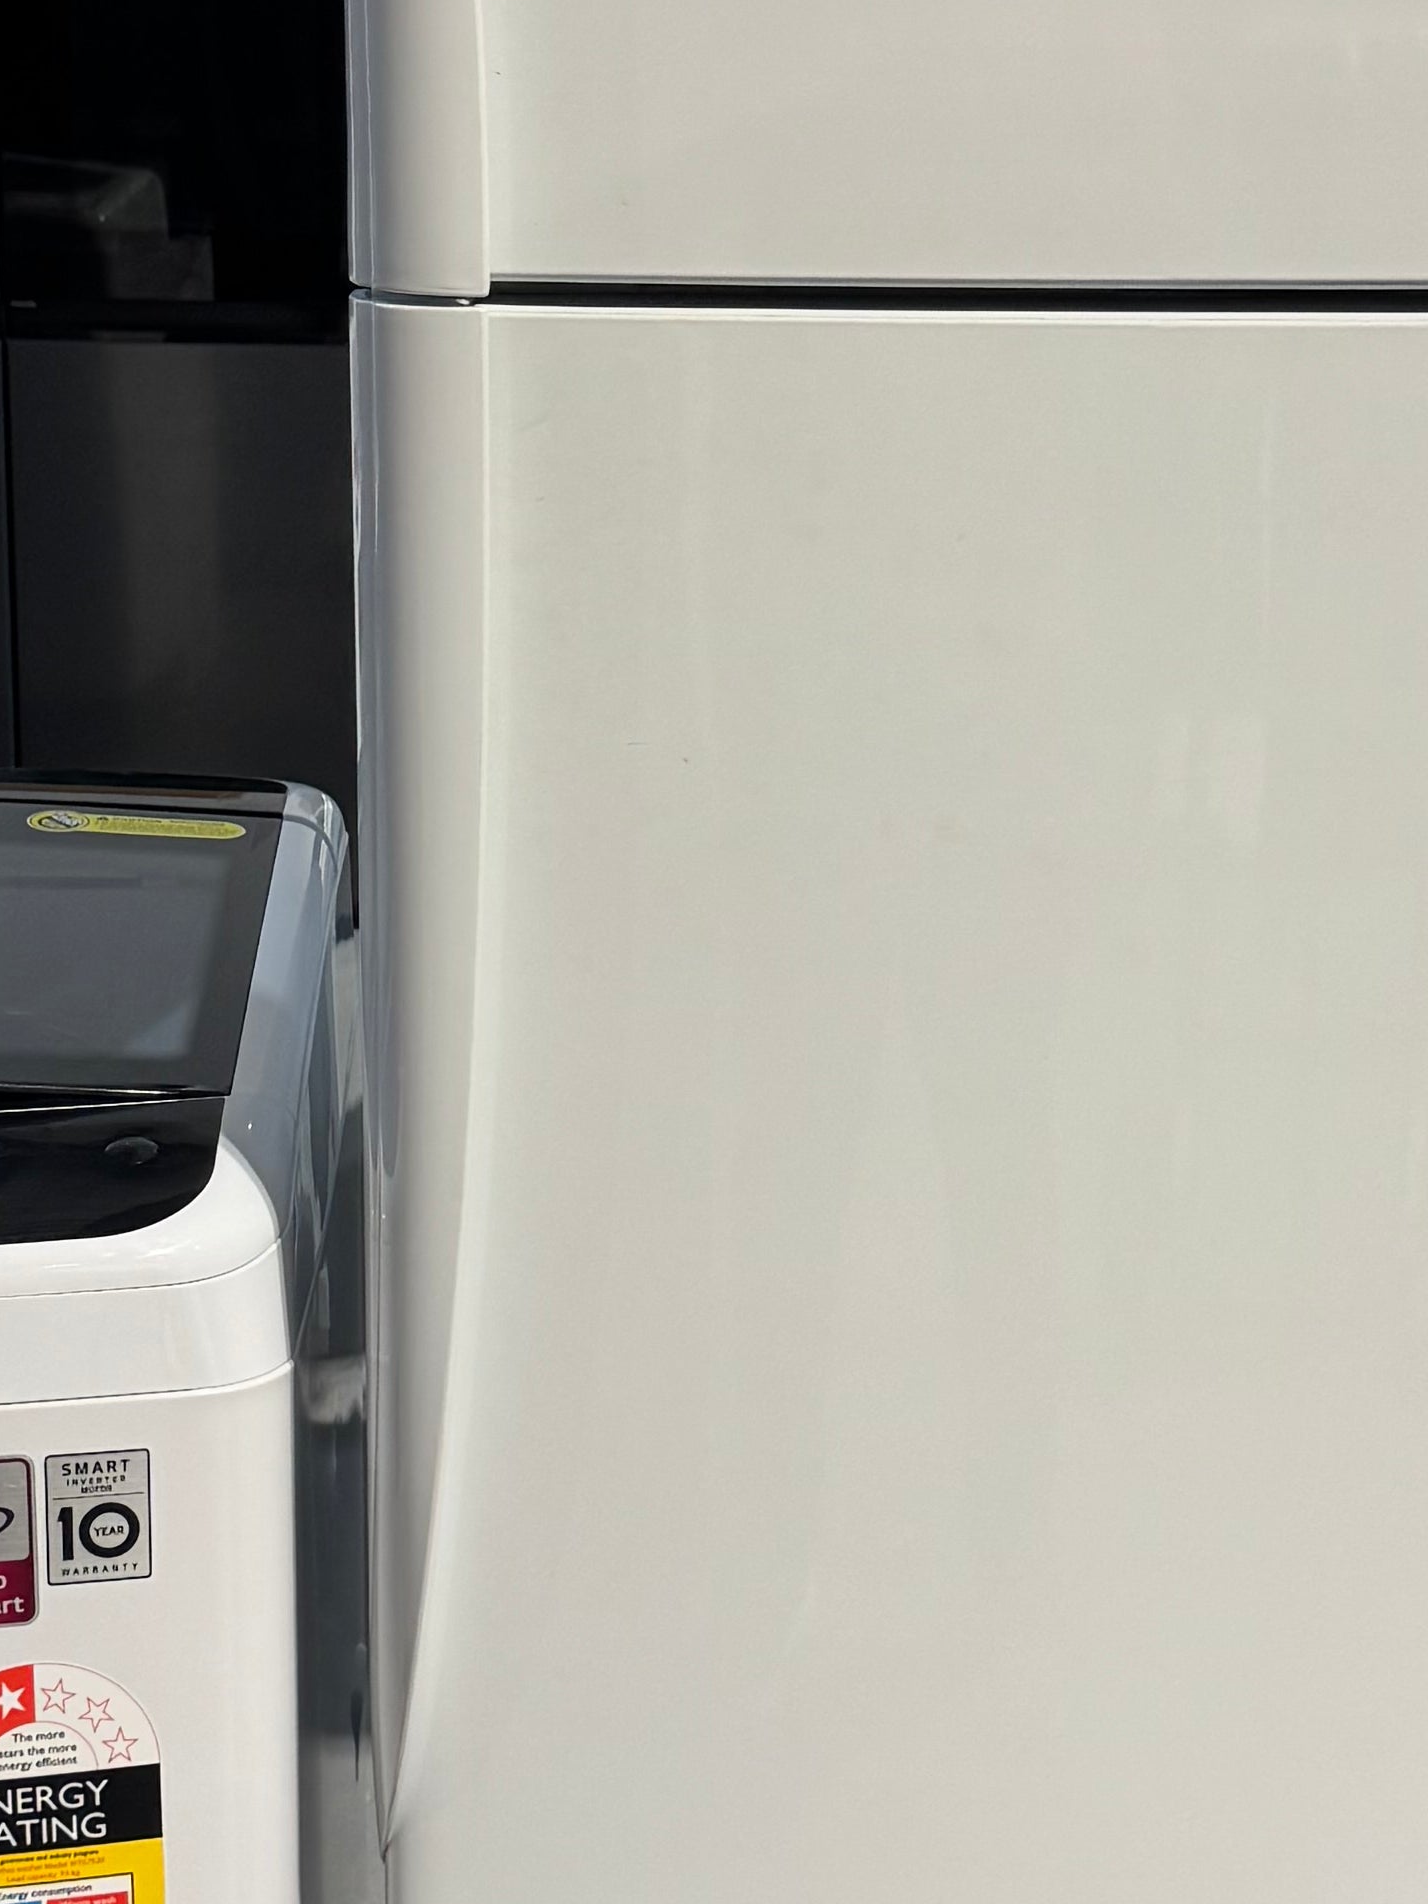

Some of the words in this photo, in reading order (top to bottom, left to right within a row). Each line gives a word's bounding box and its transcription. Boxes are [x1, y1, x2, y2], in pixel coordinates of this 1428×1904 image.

[61, 1459, 131, 1477] SMART
[57, 1501, 141, 1562] 10
[93, 1526, 125, 1539] YEAR
[61, 1562, 140, 1577] WARRANTY
[12, 1732, 33, 1743] The
[35, 1731, 66, 1741] more
[27, 1746, 46, 1756] the
[48, 1744, 78, 1754] more
[35, 1756, 78, 1768] efficient
[31, 1884, 93, 1898] consumption
